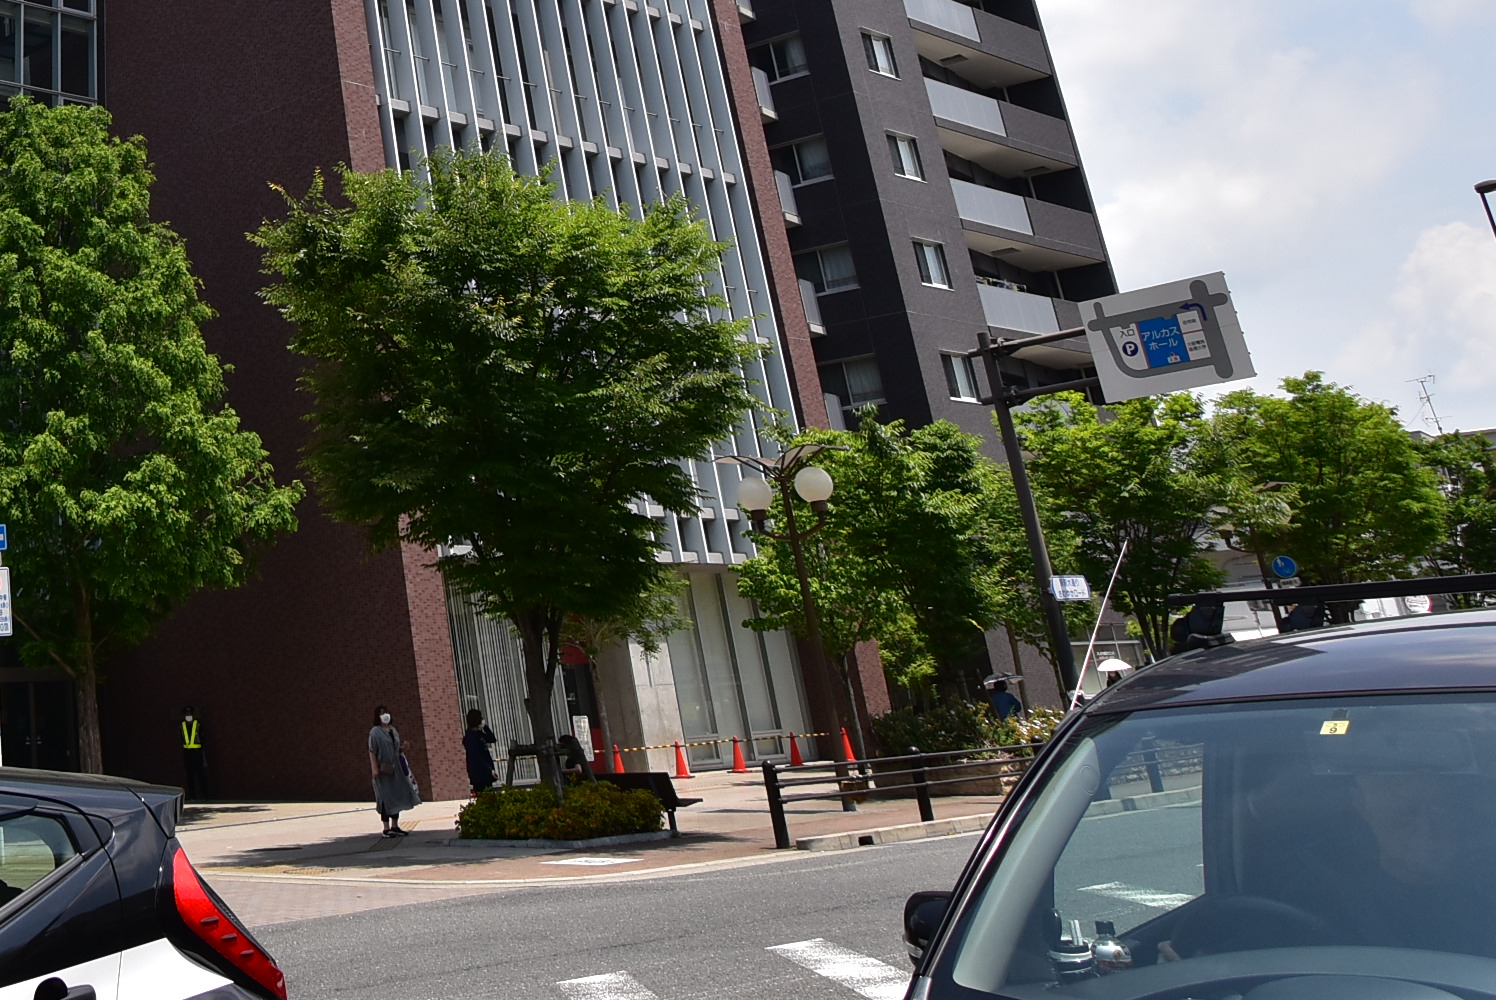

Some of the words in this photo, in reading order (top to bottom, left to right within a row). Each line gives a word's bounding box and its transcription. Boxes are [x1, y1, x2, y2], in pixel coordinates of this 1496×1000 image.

[1120, 328, 1135, 338] 入口
[1141, 326, 1180, 341] アルカス
[1126, 344, 1135, 355] P
[1149, 338, 1178, 350] ホール
